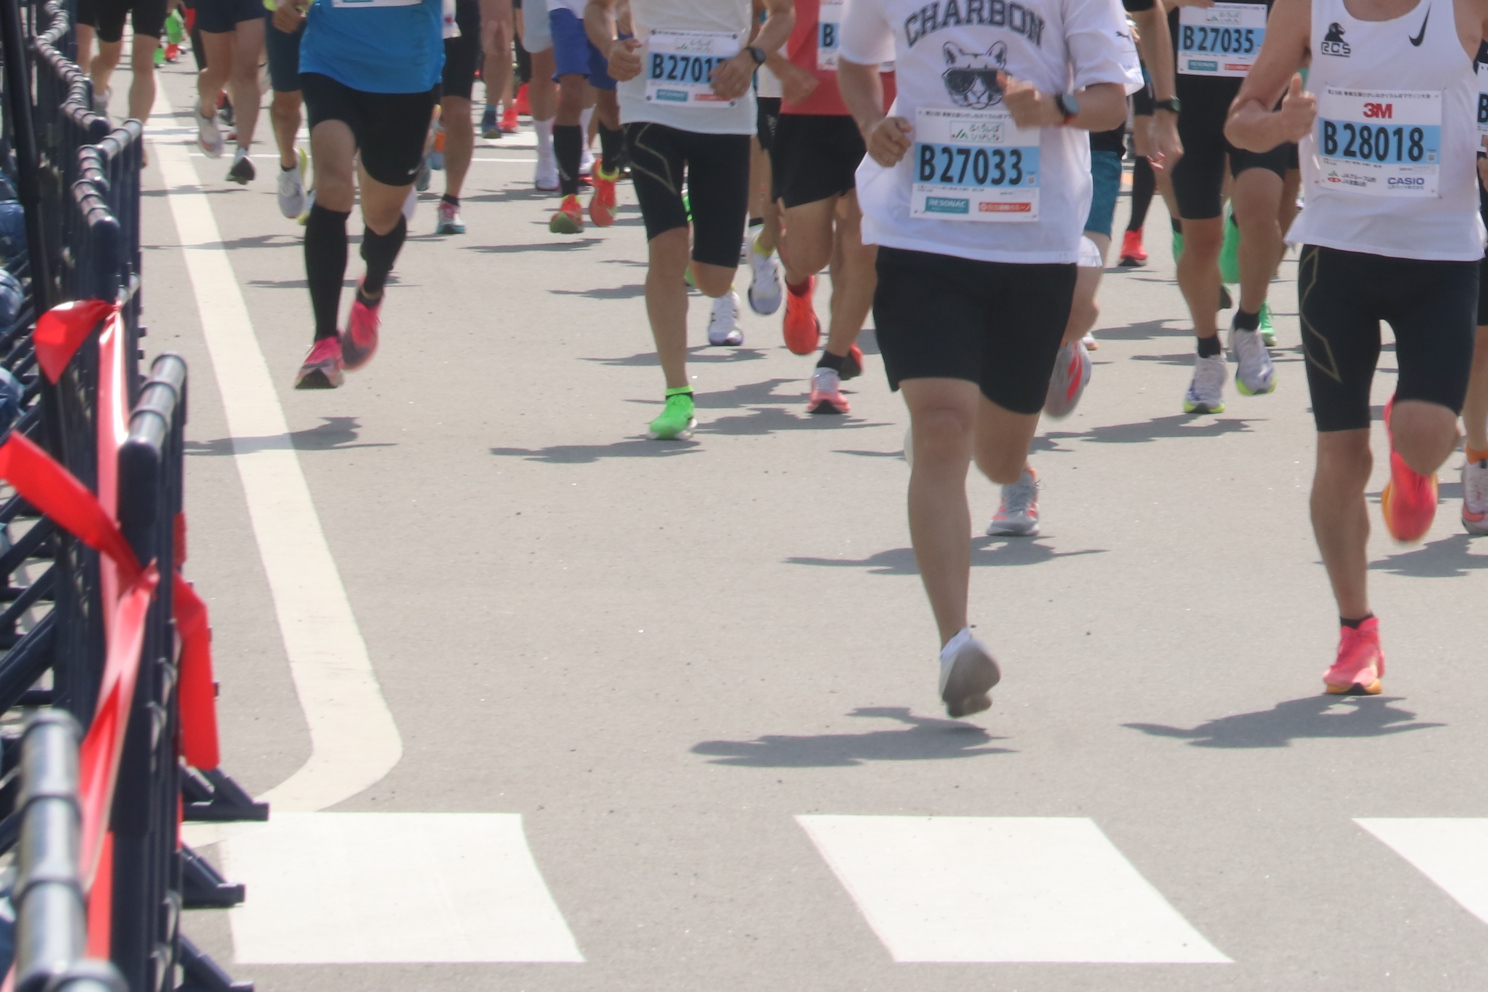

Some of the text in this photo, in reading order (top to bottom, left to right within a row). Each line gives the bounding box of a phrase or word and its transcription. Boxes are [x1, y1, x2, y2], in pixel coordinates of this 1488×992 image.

[1183, 25, 1254, 53] B27035
[1321, 41, 1352, 55] RCS
[1363, 102, 1393, 119] 3M
[1324, 120, 1424, 162] B28018
[919, 144, 1023, 186] B27033
[1387, 177, 1425, 185] CASIO
[928, 198, 967, 208] RESONAC
